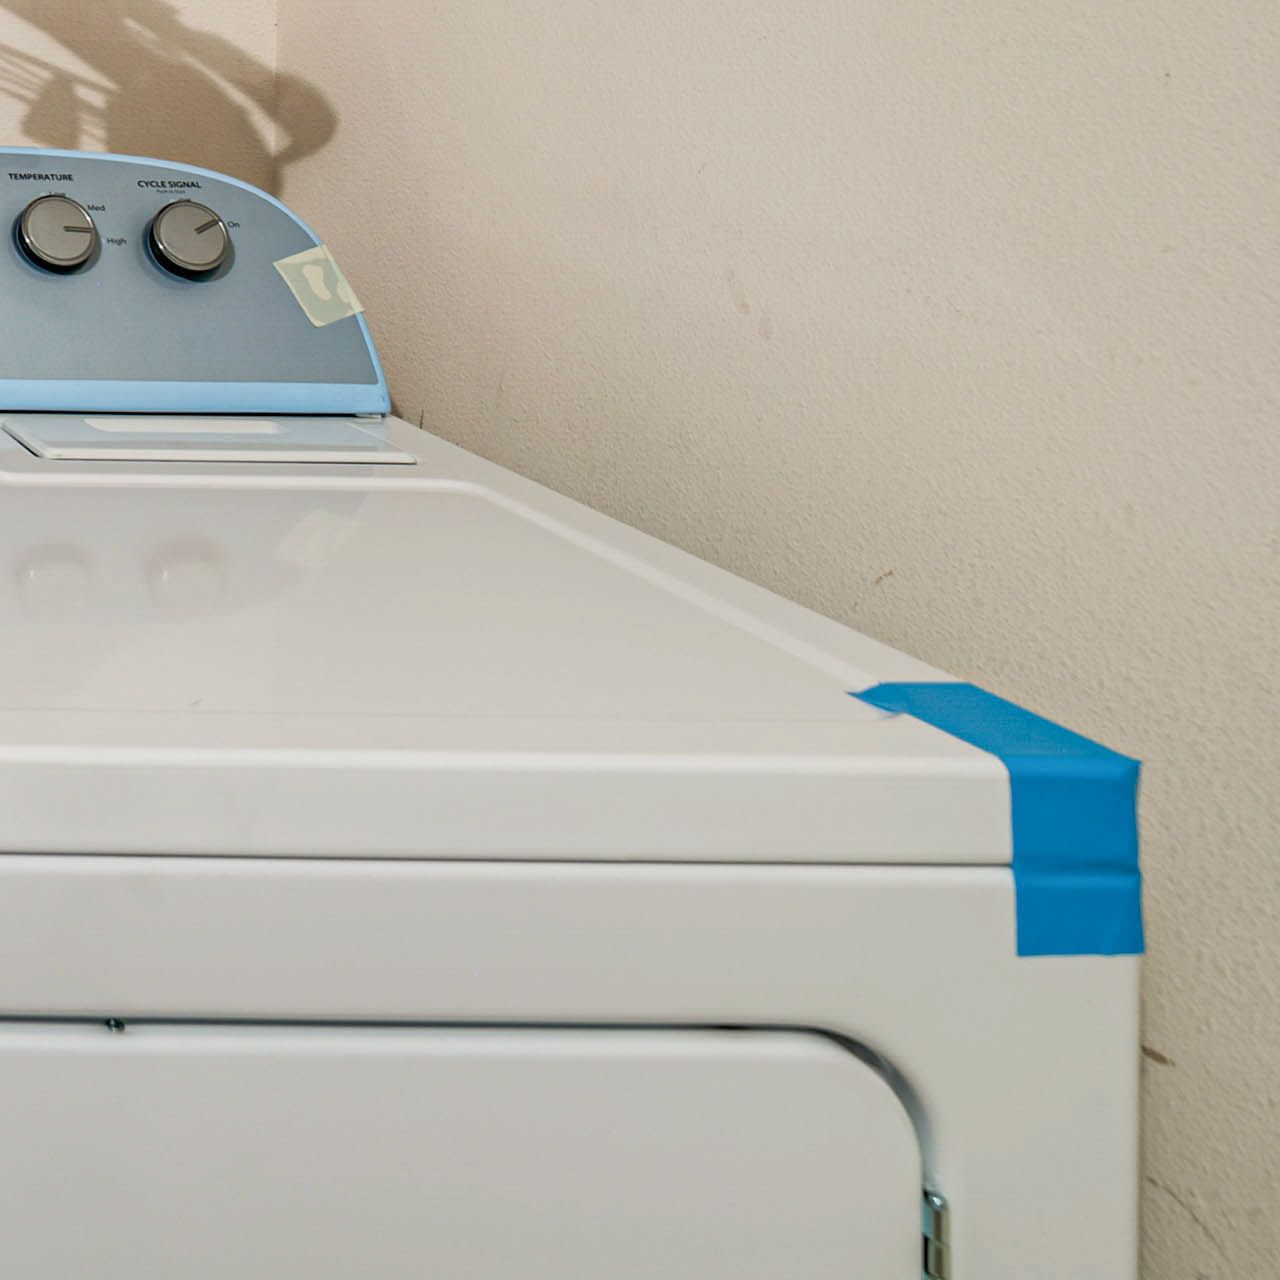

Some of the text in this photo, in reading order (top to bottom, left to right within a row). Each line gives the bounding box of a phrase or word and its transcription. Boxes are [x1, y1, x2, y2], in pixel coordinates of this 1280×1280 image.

[8, 173, 74, 182] TEMPERATURE
[137, 180, 203, 189] CYCLE SIGNAL
[87, 204, 106, 213] Med
[226, 221, 241, 230] On
[106, 237, 128, 246] High
